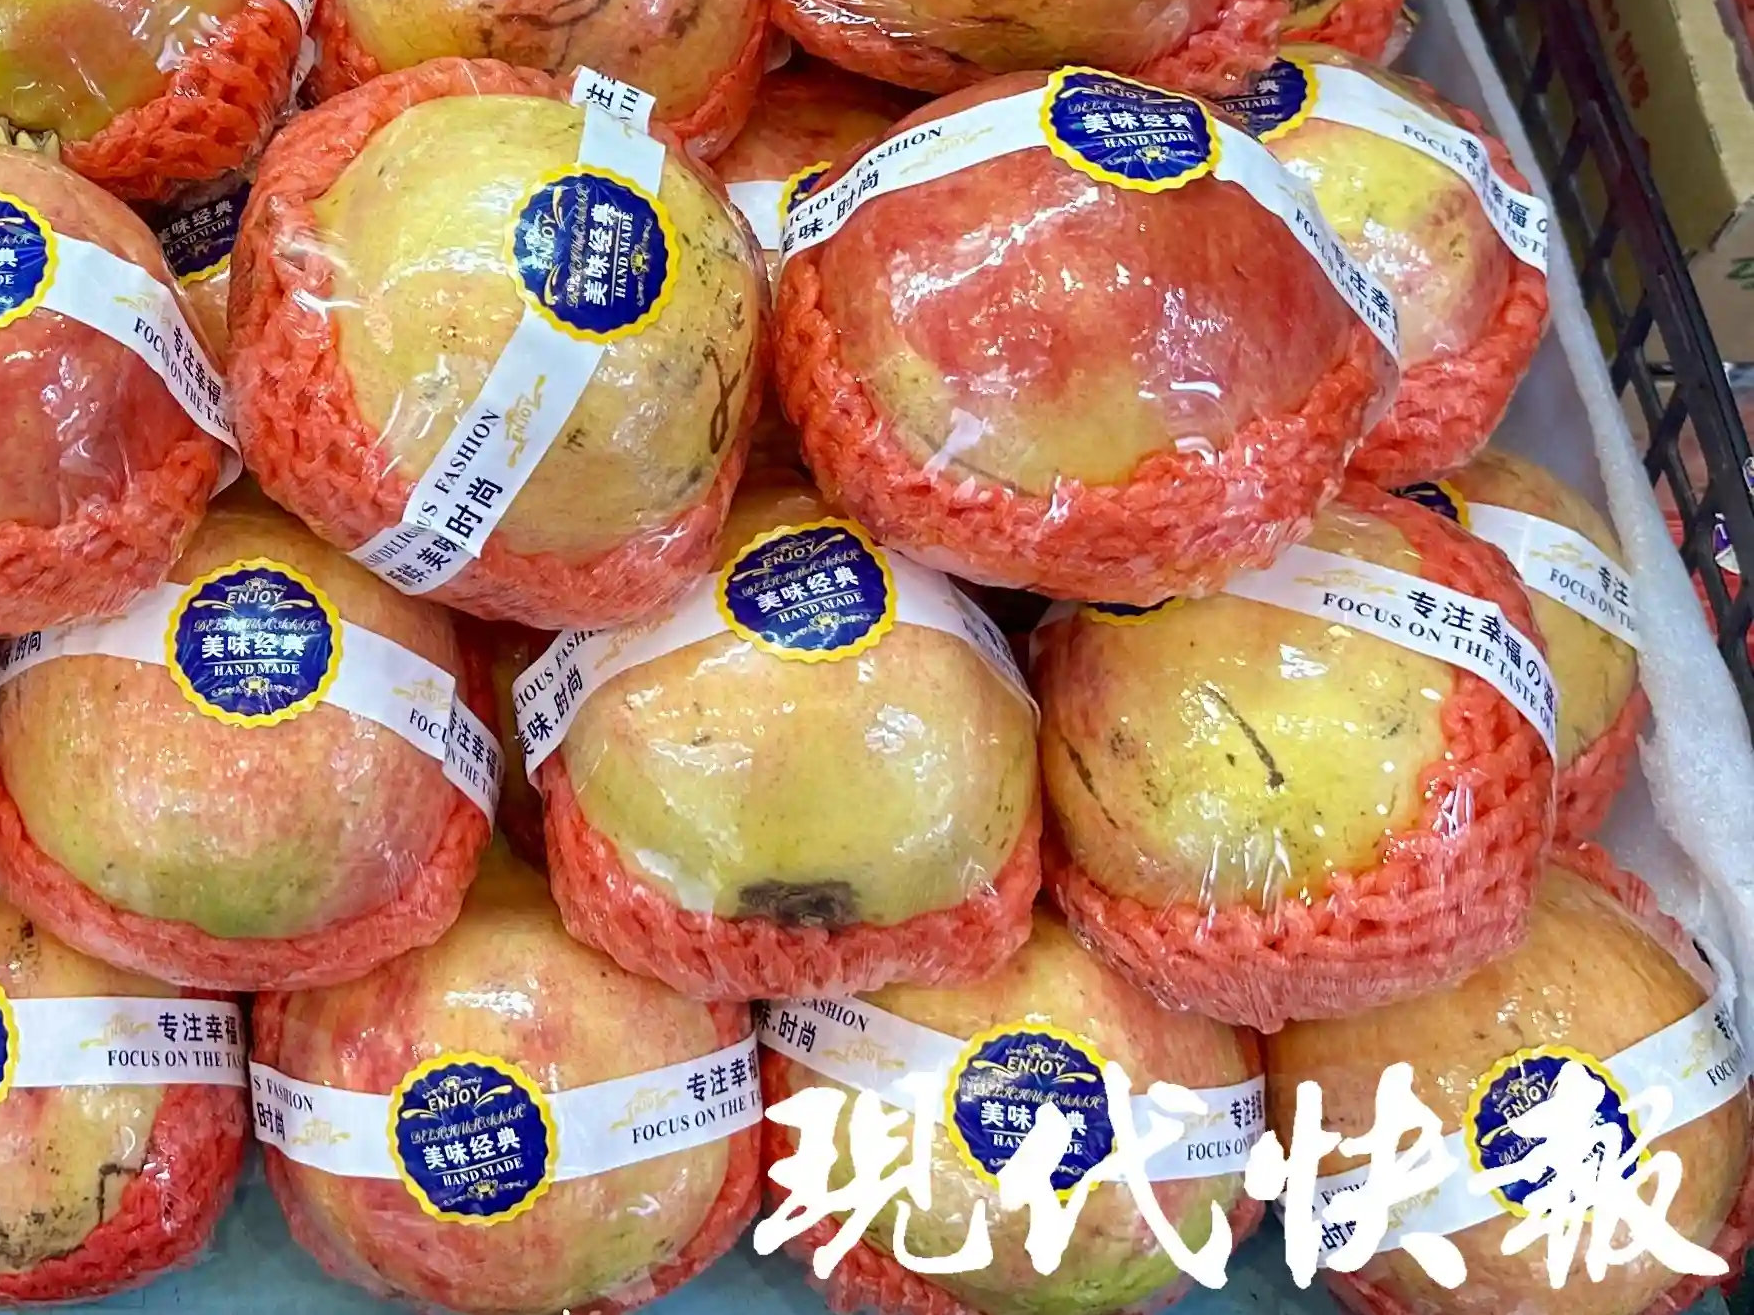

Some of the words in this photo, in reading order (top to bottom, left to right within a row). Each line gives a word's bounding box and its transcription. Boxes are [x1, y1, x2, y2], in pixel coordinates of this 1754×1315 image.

[1093, 83, 1149, 102] ENJOY
[1081, 113, 1190, 134] 美味经典
[855, 126, 944, 176] FASHION
[1103, 135, 1149, 149] HAND
[1151, 134, 1194, 147] MADE
[1402, 123, 1463, 167] FOCUS
[536, 213, 556, 272] ENJOY
[618, 212, 635, 256] MADE
[583, 202, 622, 307] 美味经典
[614, 256, 630, 300] HAND
[1357, 299, 1389, 333] THE
[132, 316, 173, 368] FOCUS
[169, 363, 187, 389] ON
[181, 383, 205, 414] THE
[434, 409, 502, 495] FASHION
[762, 540, 818, 570] ENJOY
[227, 590, 285, 605] ENJOY
[756, 566, 861, 614] 美味经典
[778, 604, 820, 626] HAND
[821, 592, 865, 615] MADE
[201, 632, 306, 660] 美味经典
[1321, 591, 1403, 630] FOCUS
[1409, 623, 1443, 644] ON
[1448, 632, 1497, 669] THE
[1497, 663, 1540, 710] TASTE
[214, 663, 254, 677] HAND
[257, 662, 300, 675] MADE
[157, 1012, 242, 1044] 专注幸福
[107, 1050, 160, 1068] FOCUS
[164, 1050, 189, 1068] ON
[194, 1051, 223, 1068] THE
[1007, 1055, 1067, 1074] ENJOY
[267, 1081, 315, 1113] FASHION
[427, 1083, 483, 1113] ENJOY
[632, 1118, 692, 1145] FOCUS
[694, 1108, 718, 1129] ON
[719, 1098, 748, 1122] THE
[980, 1100, 1088, 1138] 美味典
[422, 1130, 521, 1173] 美味经典
[1186, 1142, 1231, 1163] FOCUS
[442, 1163, 480, 1188] HAND
[481, 1155, 525, 1182] MADE
